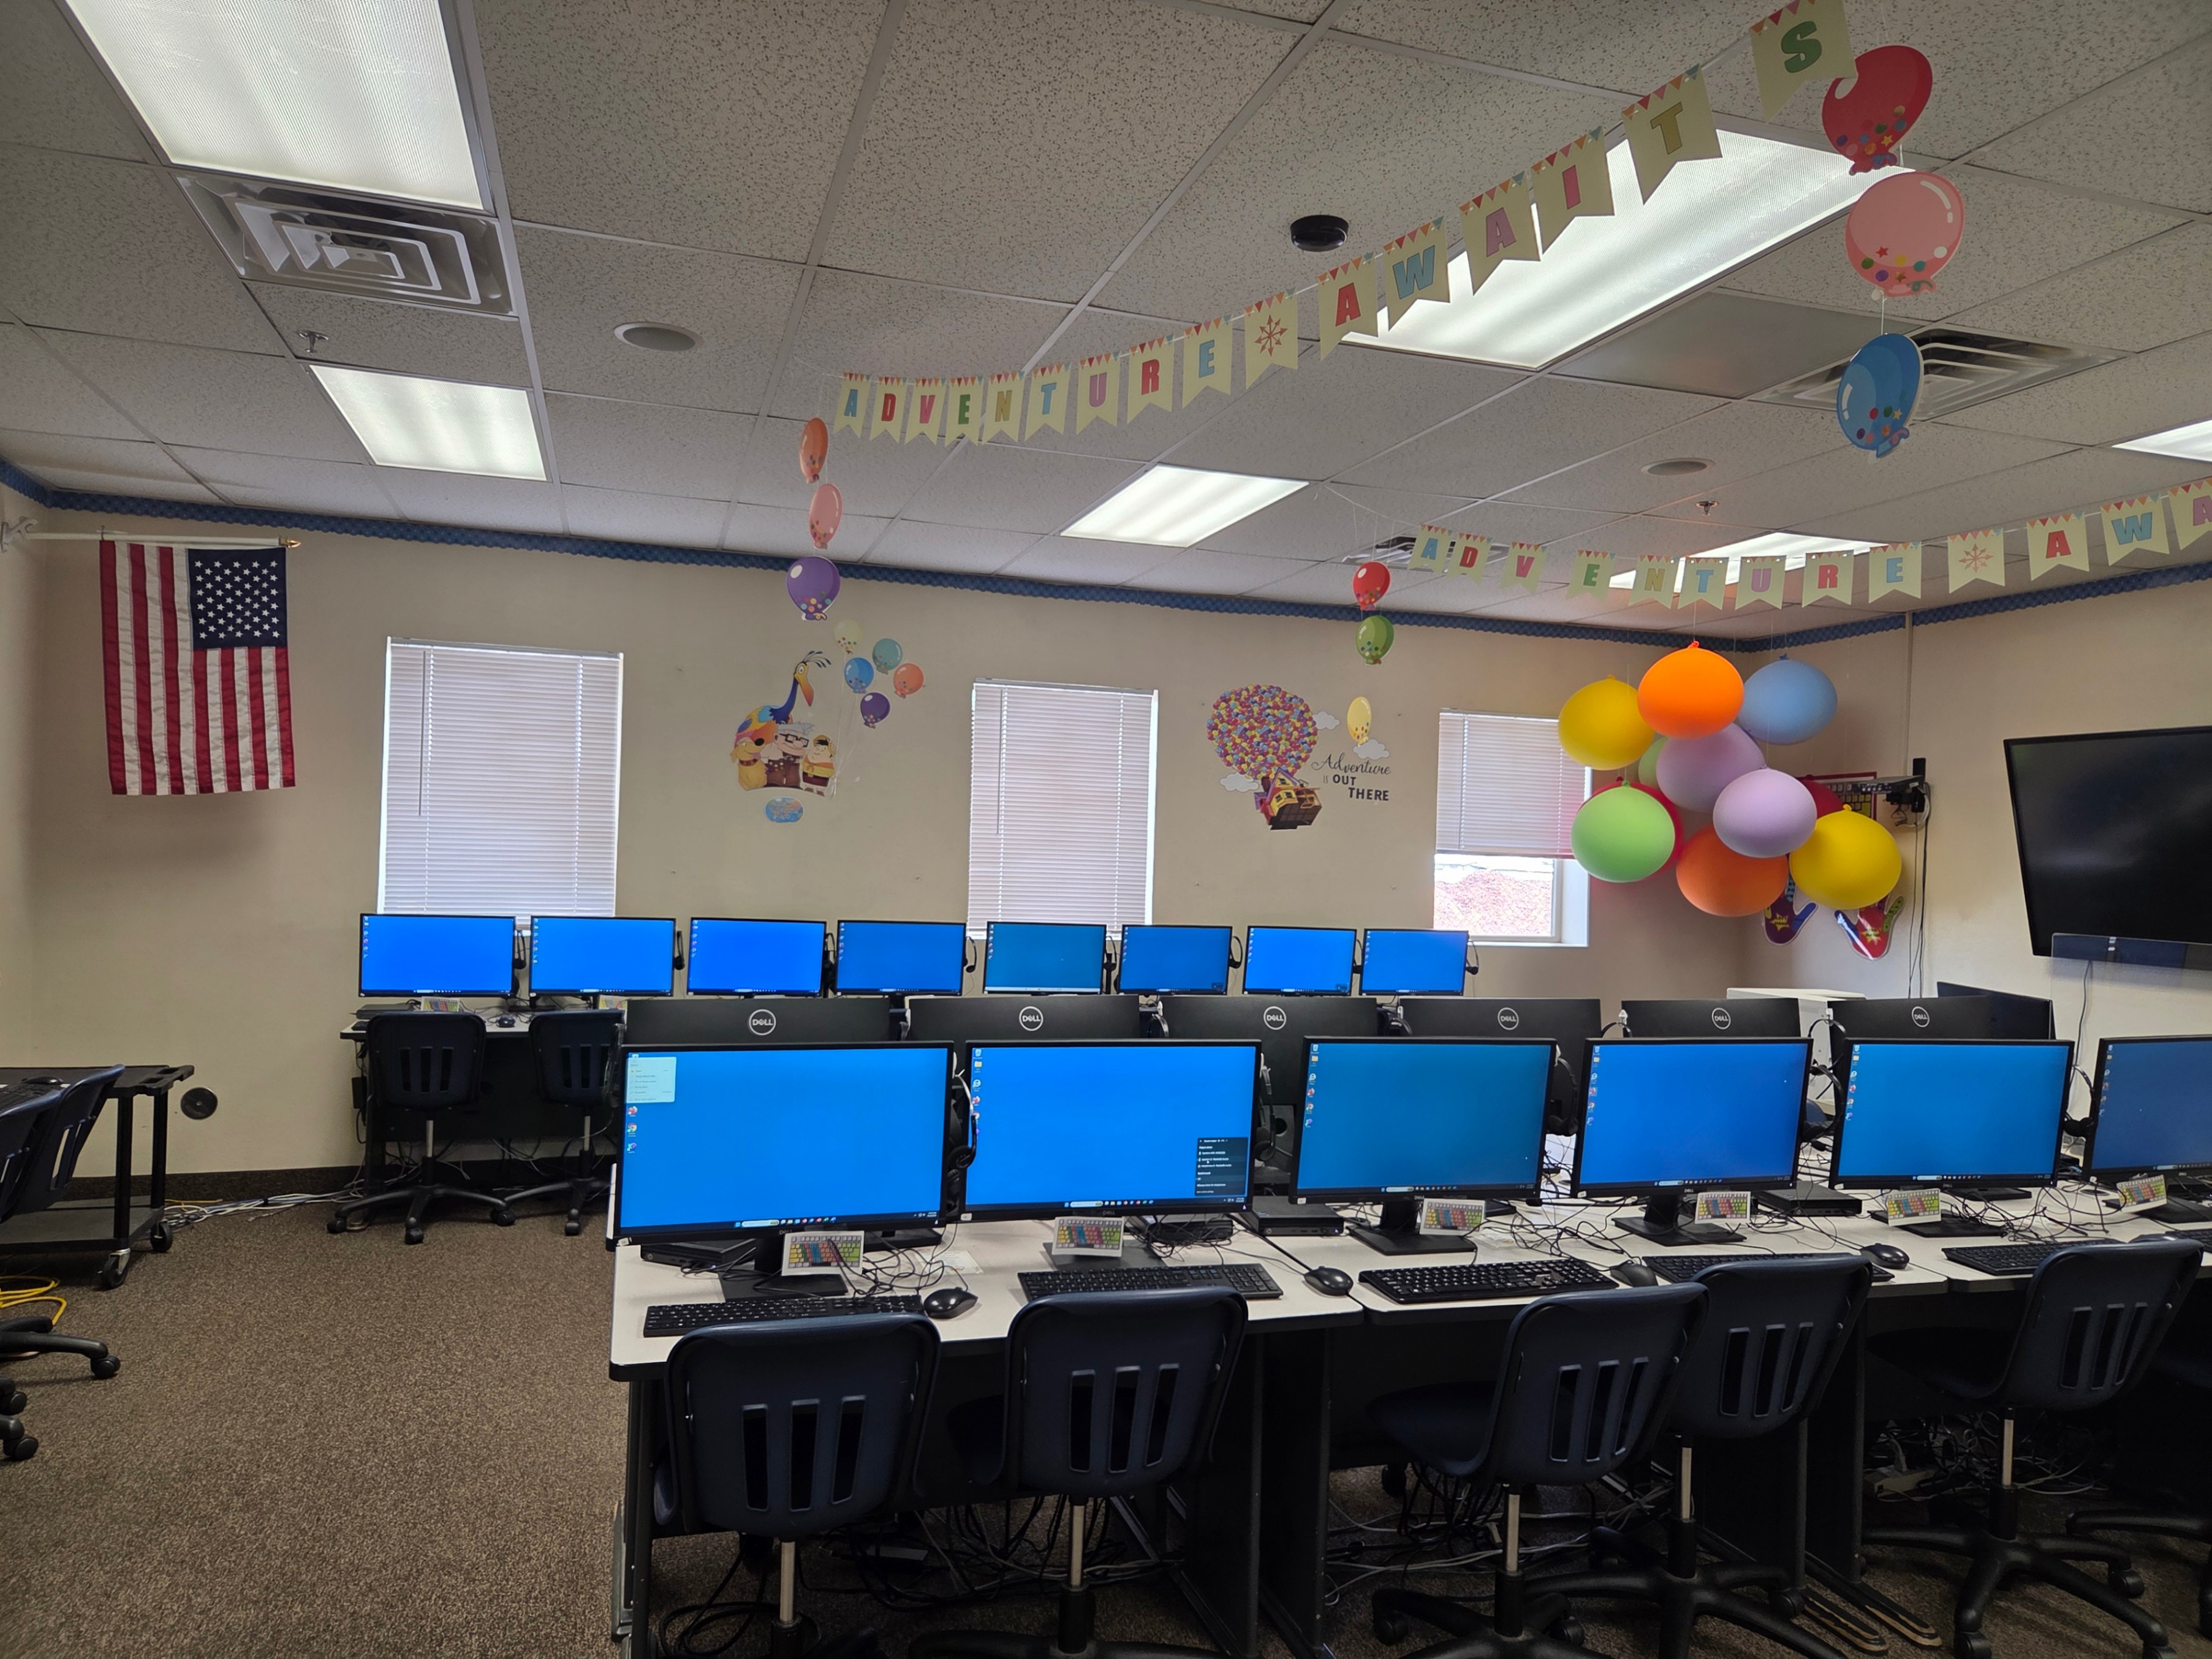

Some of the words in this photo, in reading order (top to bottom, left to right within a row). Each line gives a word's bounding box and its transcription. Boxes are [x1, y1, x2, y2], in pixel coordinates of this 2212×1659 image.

[843, 339, 1216, 425] ADVENTURE
[1335, 20, 1822, 327] AWAITS
[1420, 537, 1903, 593] ADVENTURE
[1311, 752, 1391, 775] Adventure
[1333, 774, 1356, 786] OUT
[1348, 787, 1389, 801] THERE
